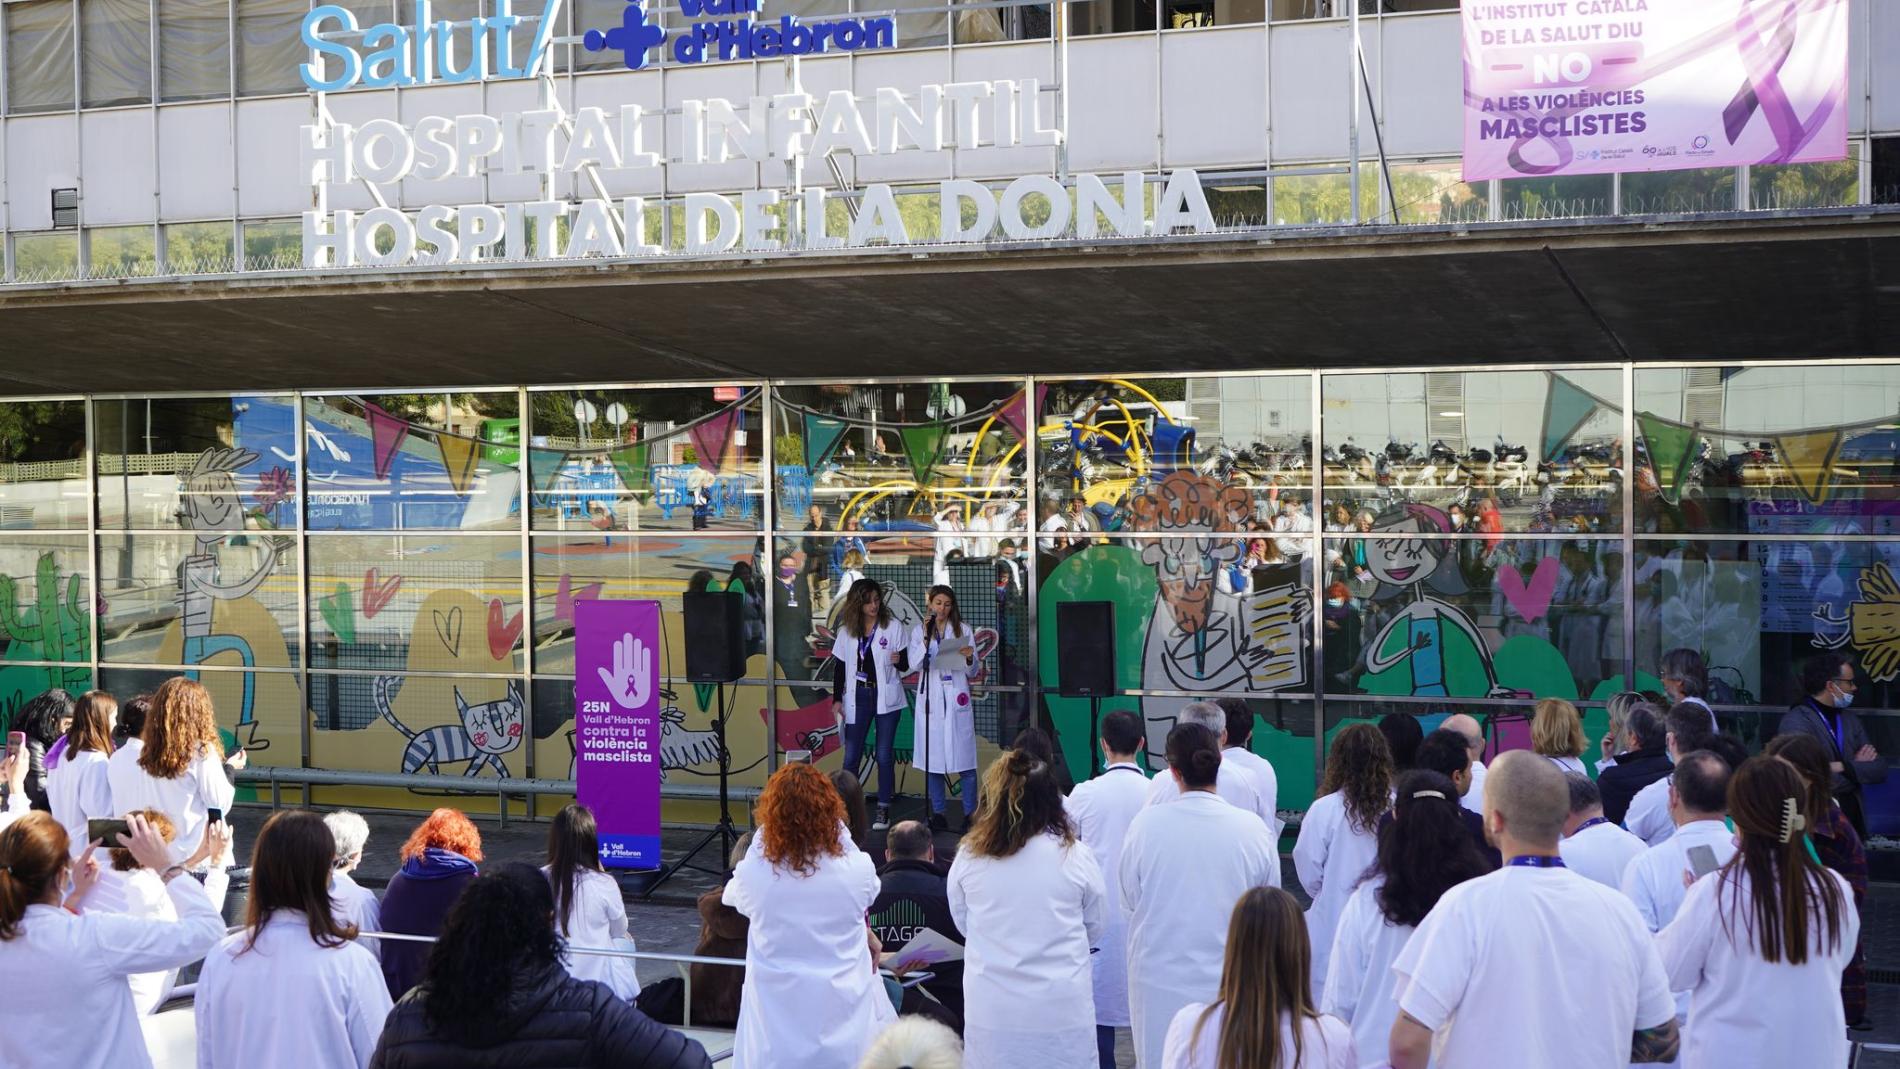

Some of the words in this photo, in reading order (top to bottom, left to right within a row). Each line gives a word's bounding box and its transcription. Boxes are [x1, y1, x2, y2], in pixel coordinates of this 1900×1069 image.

[1472, 3, 1568, 21] L'INSTITUT
[674, 15, 897, 64] d'Hebron
[1480, 29, 1507, 46] DE
[1511, 28, 1536, 44] LA
[1540, 24, 1603, 43] SALUT
[1607, 22, 1644, 39] DIU
[1533, 51, 1593, 84] NO
[1481, 98, 1495, 113] A
[1498, 96, 1530, 112] LES
[1533, 89, 1646, 110] VIOLÈNCIES
[300, 104, 660, 186] HOSPITAL
[682, 78, 1063, 165] INFANTIL
[1480, 111, 1648, 141] MASCLISTES
[302, 198, 663, 269] HOSPITAL
[686, 189, 780, 254] DE
[805, 183, 911, 250] LA
[940, 169, 1218, 241] DONA
[583, 701, 610, 713] 25N
[583, 715, 603, 724] Vall
[604, 715, 651, 725] d'Hebron
[583, 726, 630, 737] contra
[633, 726, 647, 737] la
[583, 736, 648, 750] violència
[583, 750, 653, 763] masclista
